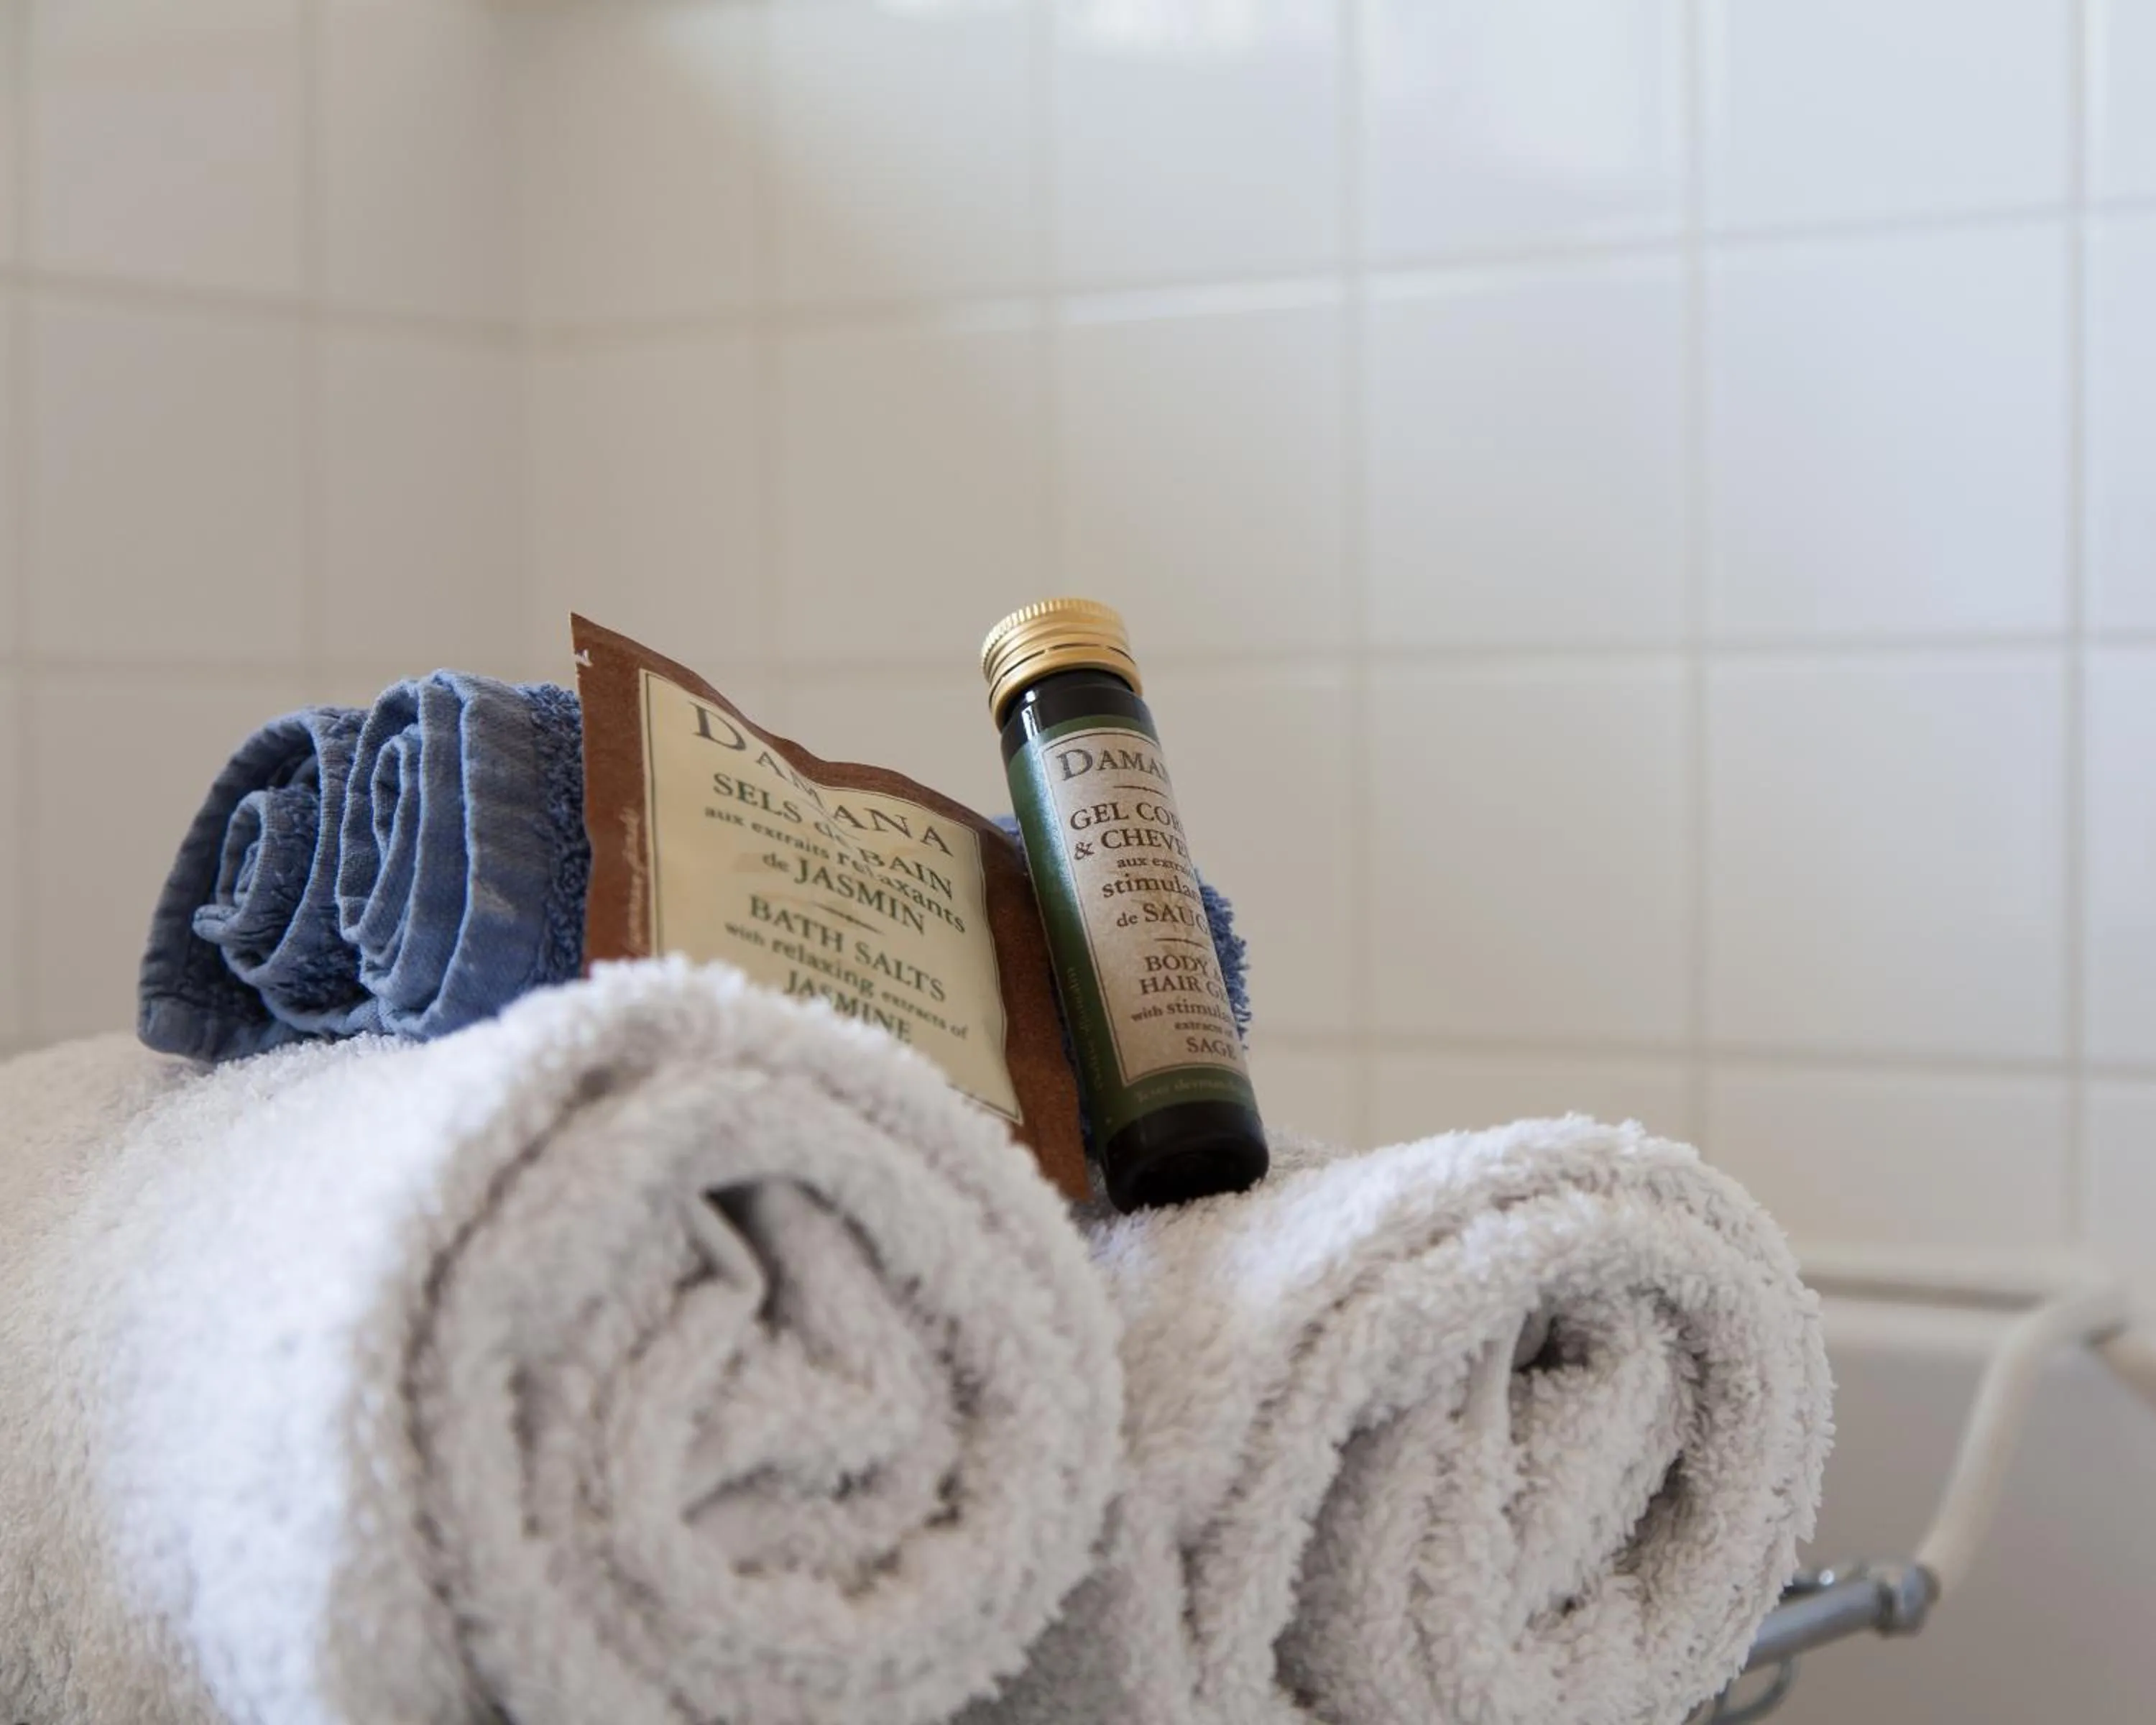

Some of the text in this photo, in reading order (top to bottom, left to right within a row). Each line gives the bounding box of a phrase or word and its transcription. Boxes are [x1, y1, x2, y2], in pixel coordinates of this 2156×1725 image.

[1070, 802, 1129, 830] GEL
[712, 772, 803, 824] SELS
[857, 847, 952, 900] BAIN
[1074, 842, 1095, 860] &
[1117, 857, 1148, 868] aux
[704, 806, 966, 933] aux extraits relaxants
[762, 852, 924, 934] de JASMIN
[1117, 912, 1138, 927] de
[724, 921, 765, 947] with
[772, 937, 875, 999] relaxing
[750, 895, 946, 1003] BATH SALTS
[1145, 954, 1208, 976] BODY
[1139, 975, 1202, 995] HAIR
[1130, 1007, 1164, 1022] with
[1186, 1036, 1238, 1060] SAGE
